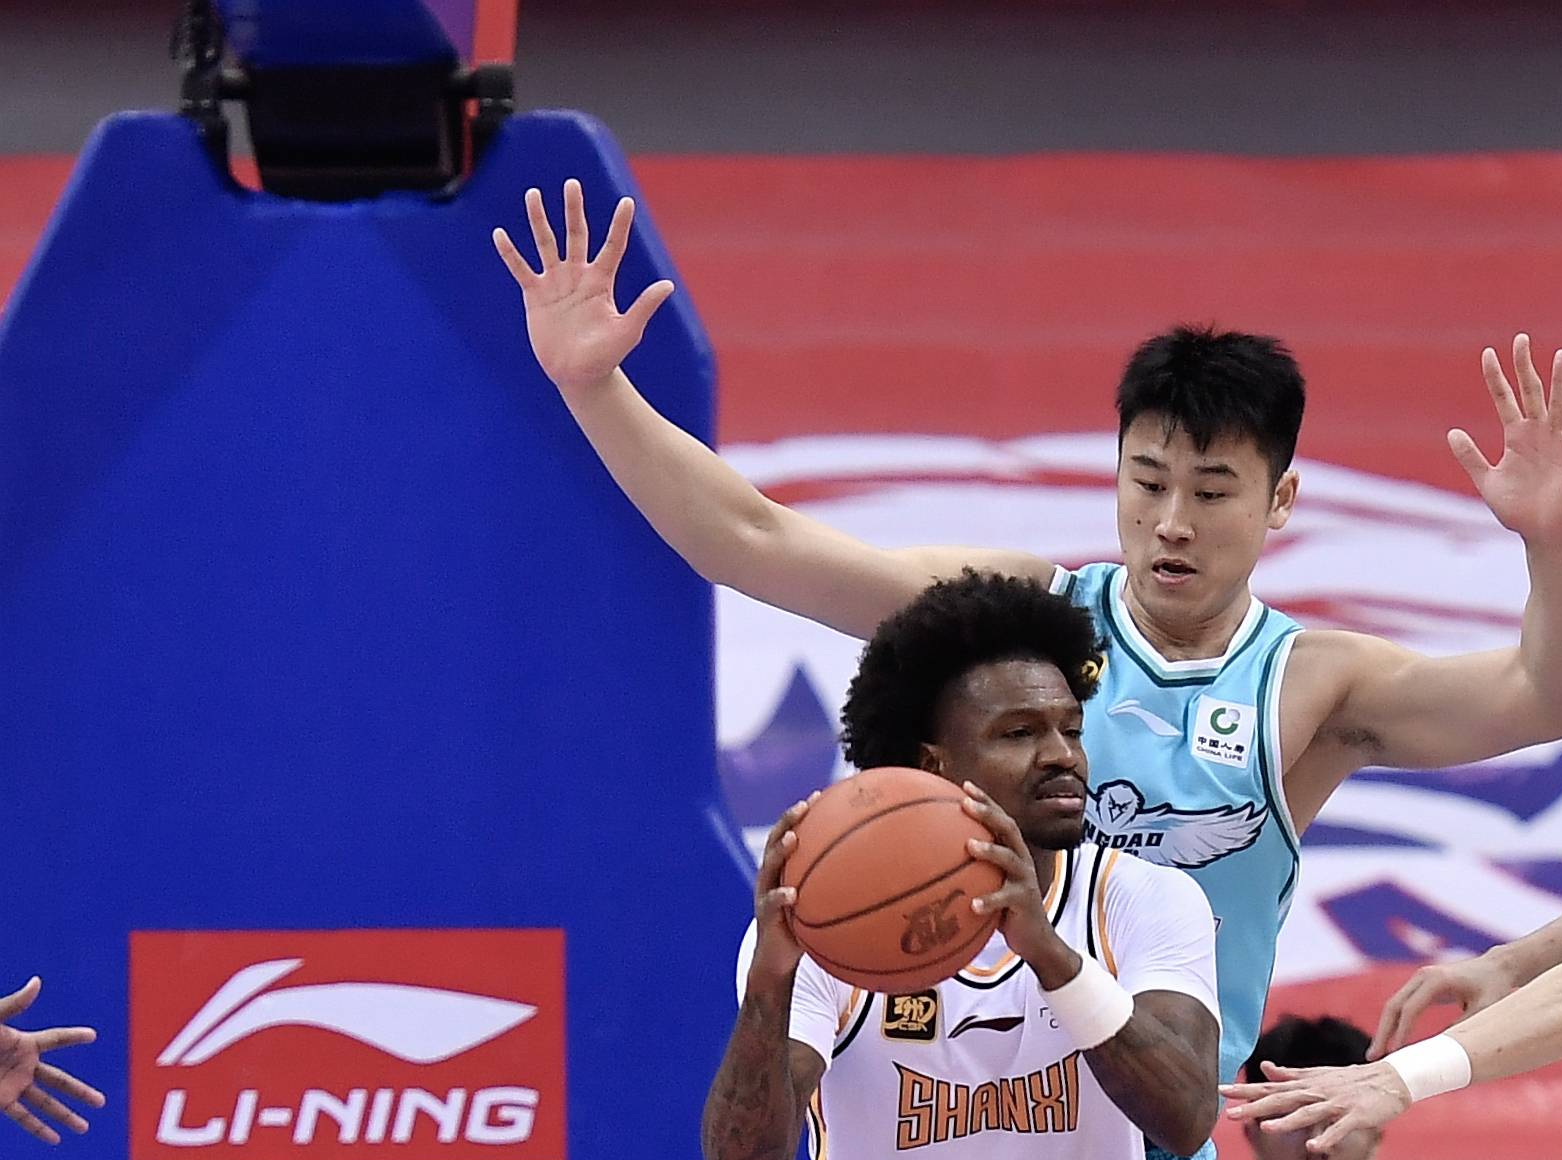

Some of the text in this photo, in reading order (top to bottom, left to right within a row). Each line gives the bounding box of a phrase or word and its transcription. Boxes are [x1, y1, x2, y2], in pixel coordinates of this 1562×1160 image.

[1197, 746, 1221, 757] CHINA
[155, 1086, 540, 1147] LI-NING
[892, 1049, 1081, 1151] SHANXI
